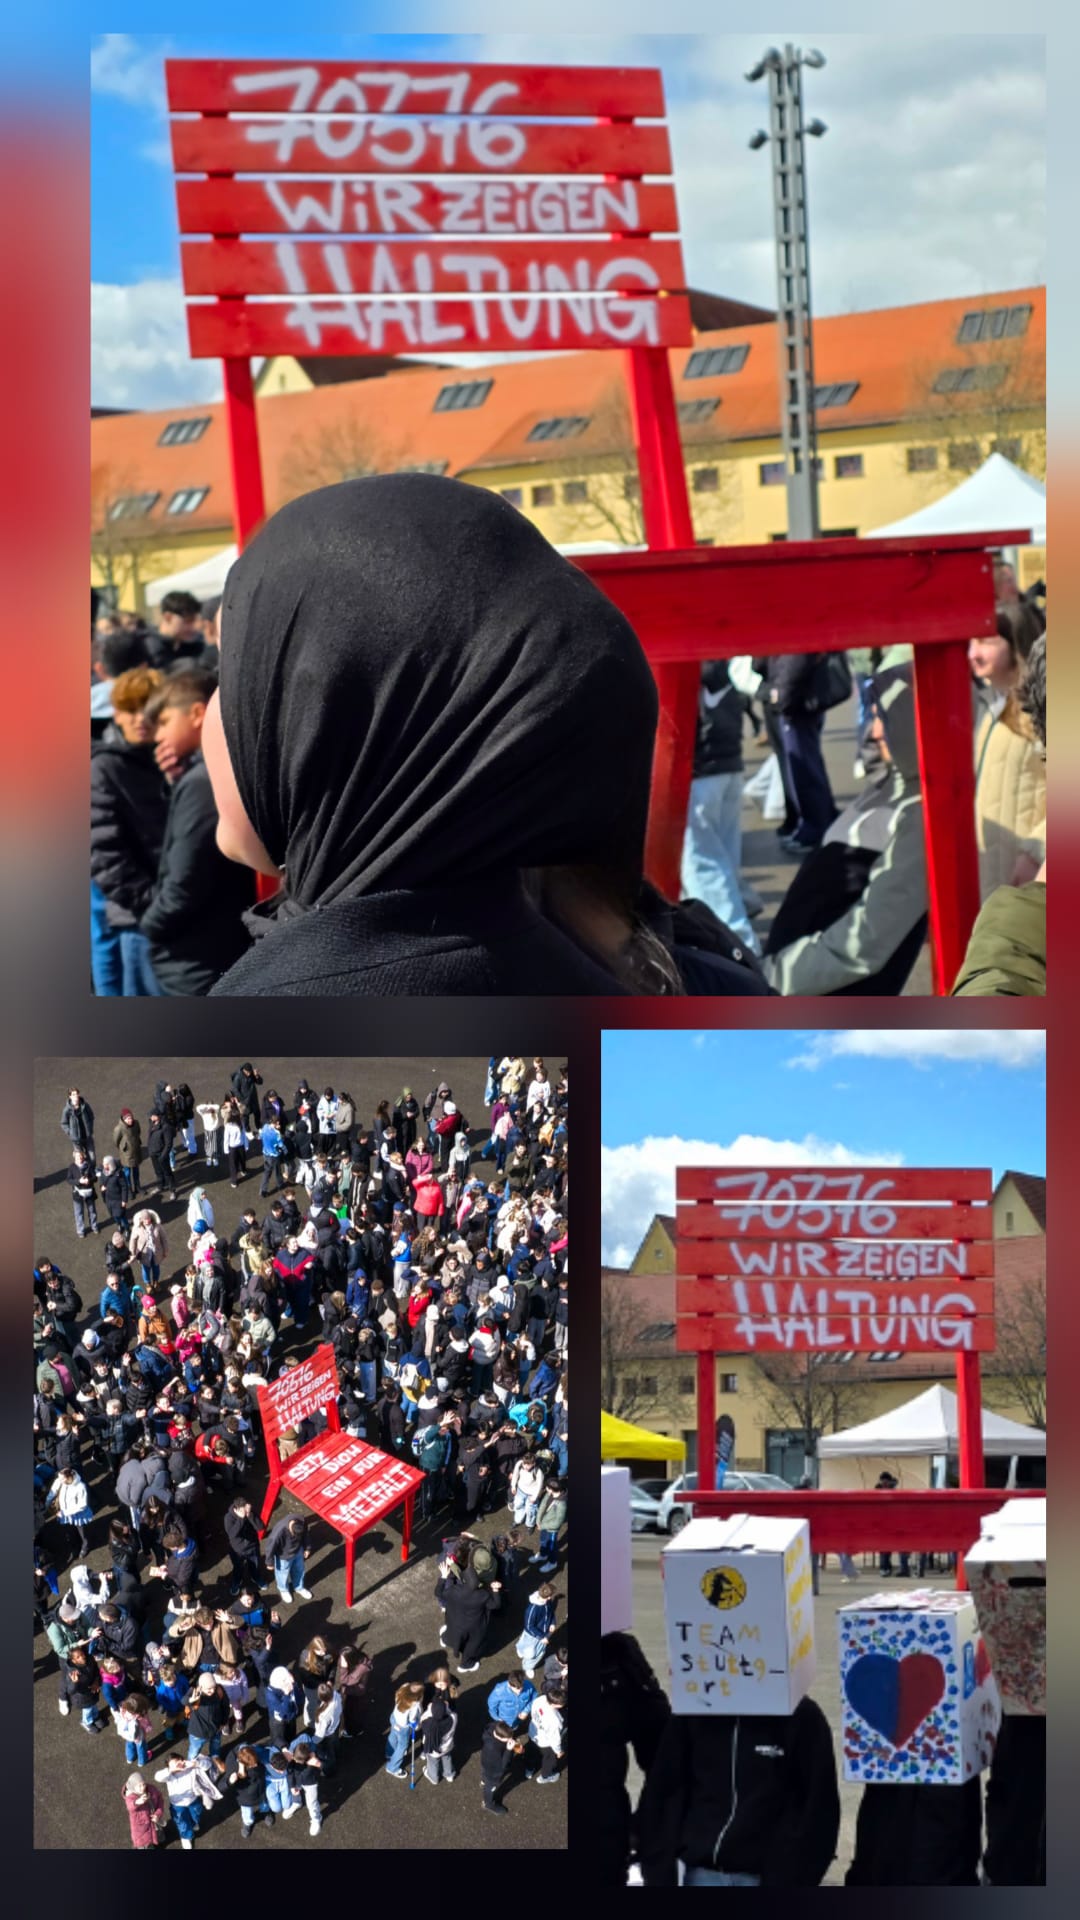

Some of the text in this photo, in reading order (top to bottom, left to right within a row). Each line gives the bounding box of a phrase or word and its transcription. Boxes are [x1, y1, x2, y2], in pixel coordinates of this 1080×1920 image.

[232, 67, 528, 167] 70376
[276, 241, 661, 347] HALTUNG
[715, 1171, 897, 1234] 70376
[732, 1280, 976, 1350] HALTUNG
[288, 1451, 330, 1481] SETZ
[675, 1622, 761, 1646] TEAM
[685, 1678, 730, 1696] art
